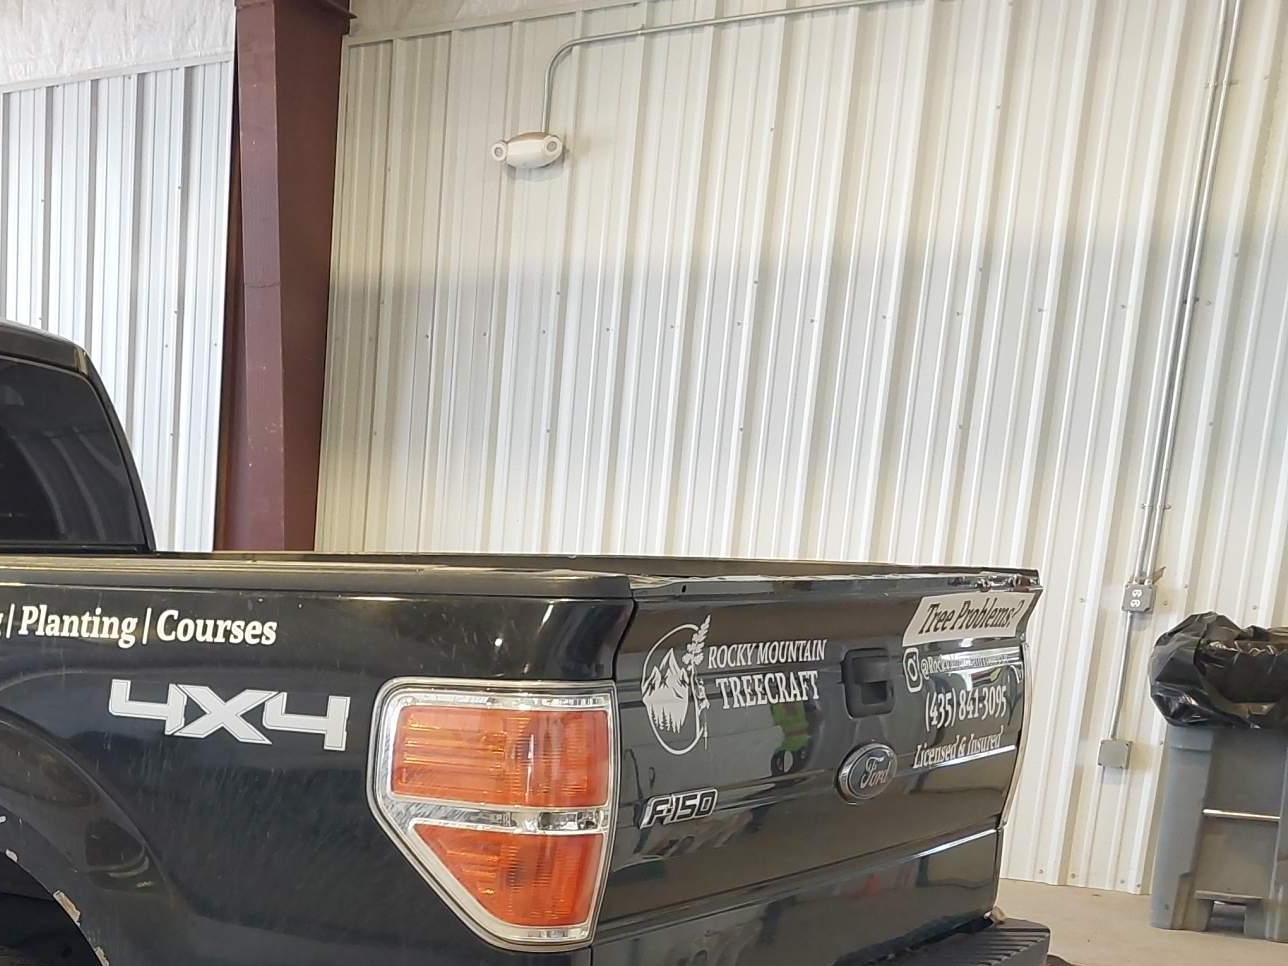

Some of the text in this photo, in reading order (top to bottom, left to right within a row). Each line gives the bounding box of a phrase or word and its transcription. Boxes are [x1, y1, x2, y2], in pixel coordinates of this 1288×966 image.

[18, 604, 137, 649] Planting
[156, 609, 278, 646] Courses
[918, 597, 1026, 634] Tree Problems?
[708, 639, 828, 669] ROCKY MOUNTAIN
[715, 670, 820, 710] TREECRAFT
[925, 684, 1007, 732] (435) 841-3095
[912, 724, 1004, 769] Licensed & Insured
[860, 755, 891, 790] Ford
